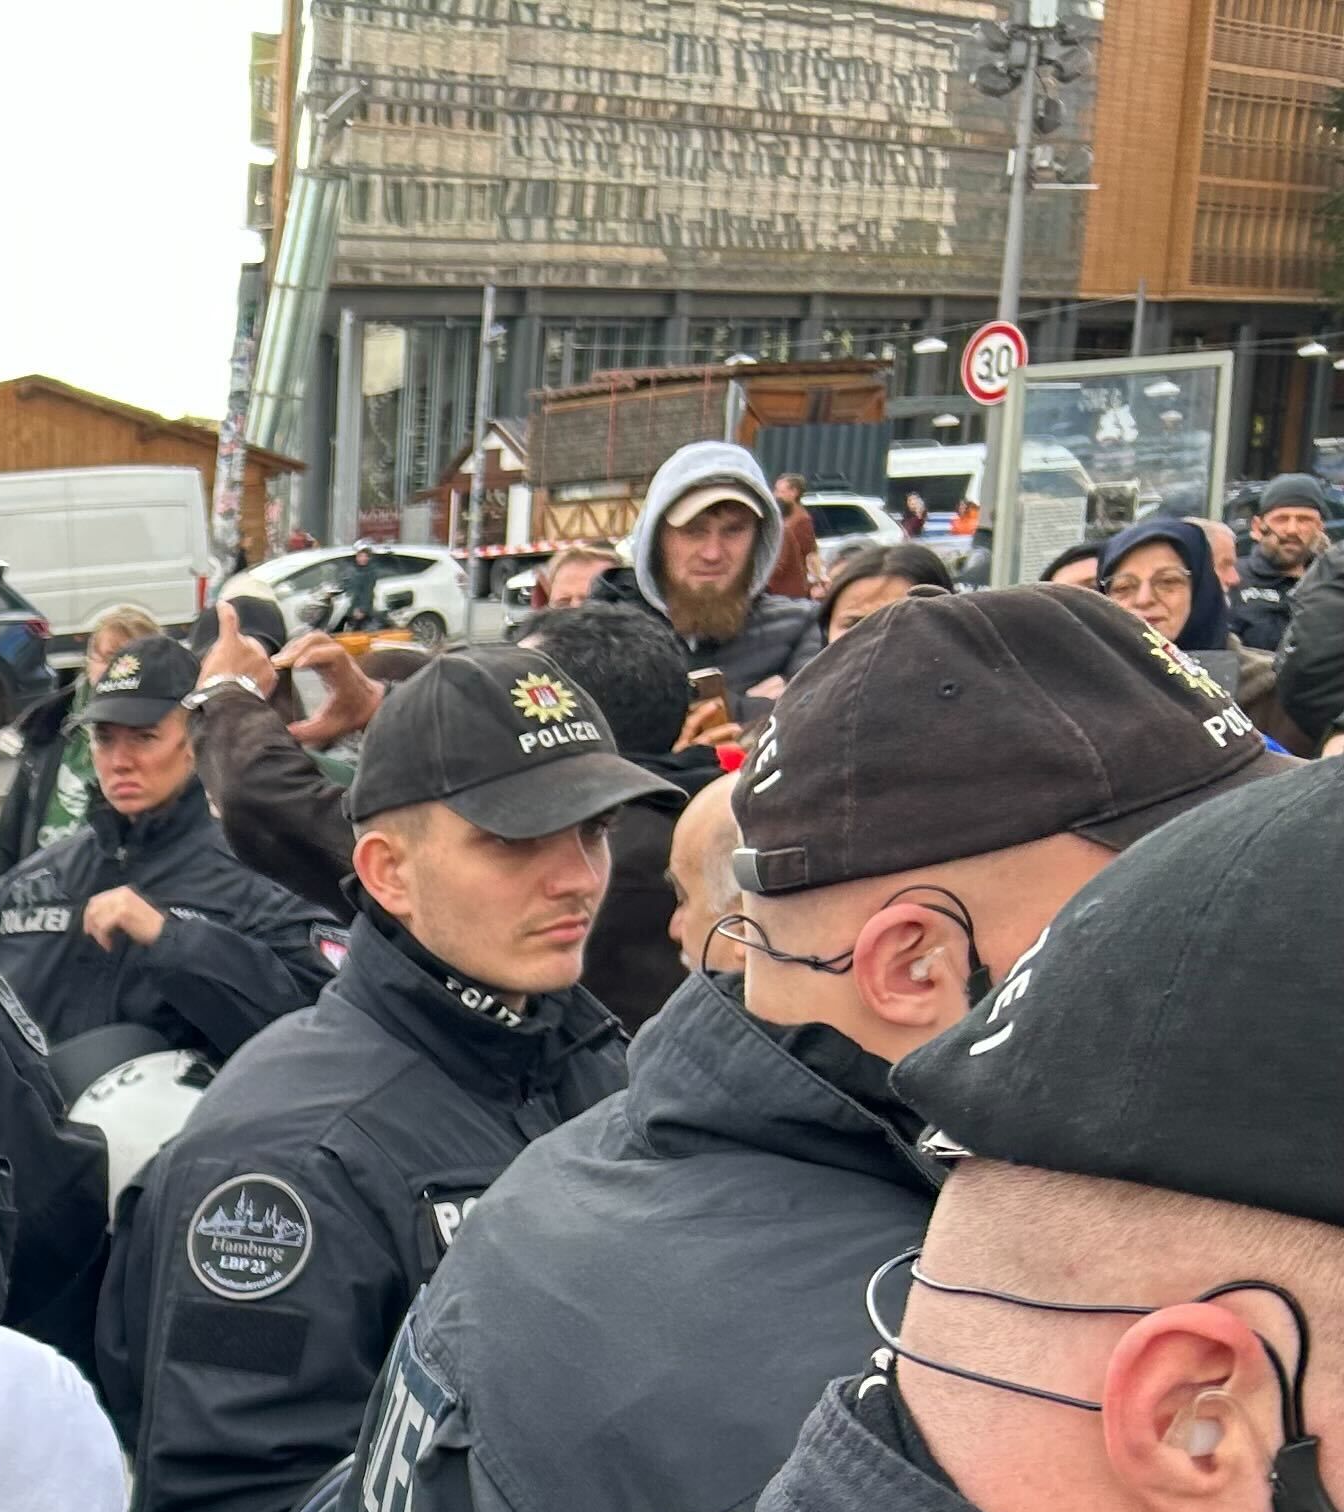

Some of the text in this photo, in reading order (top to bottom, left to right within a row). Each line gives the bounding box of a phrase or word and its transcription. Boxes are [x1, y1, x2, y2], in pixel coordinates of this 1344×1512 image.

[976, 345, 1013, 383] 30
[211, 1236, 284, 1264] Hamburg
[219, 1255, 249, 1271] LBP
